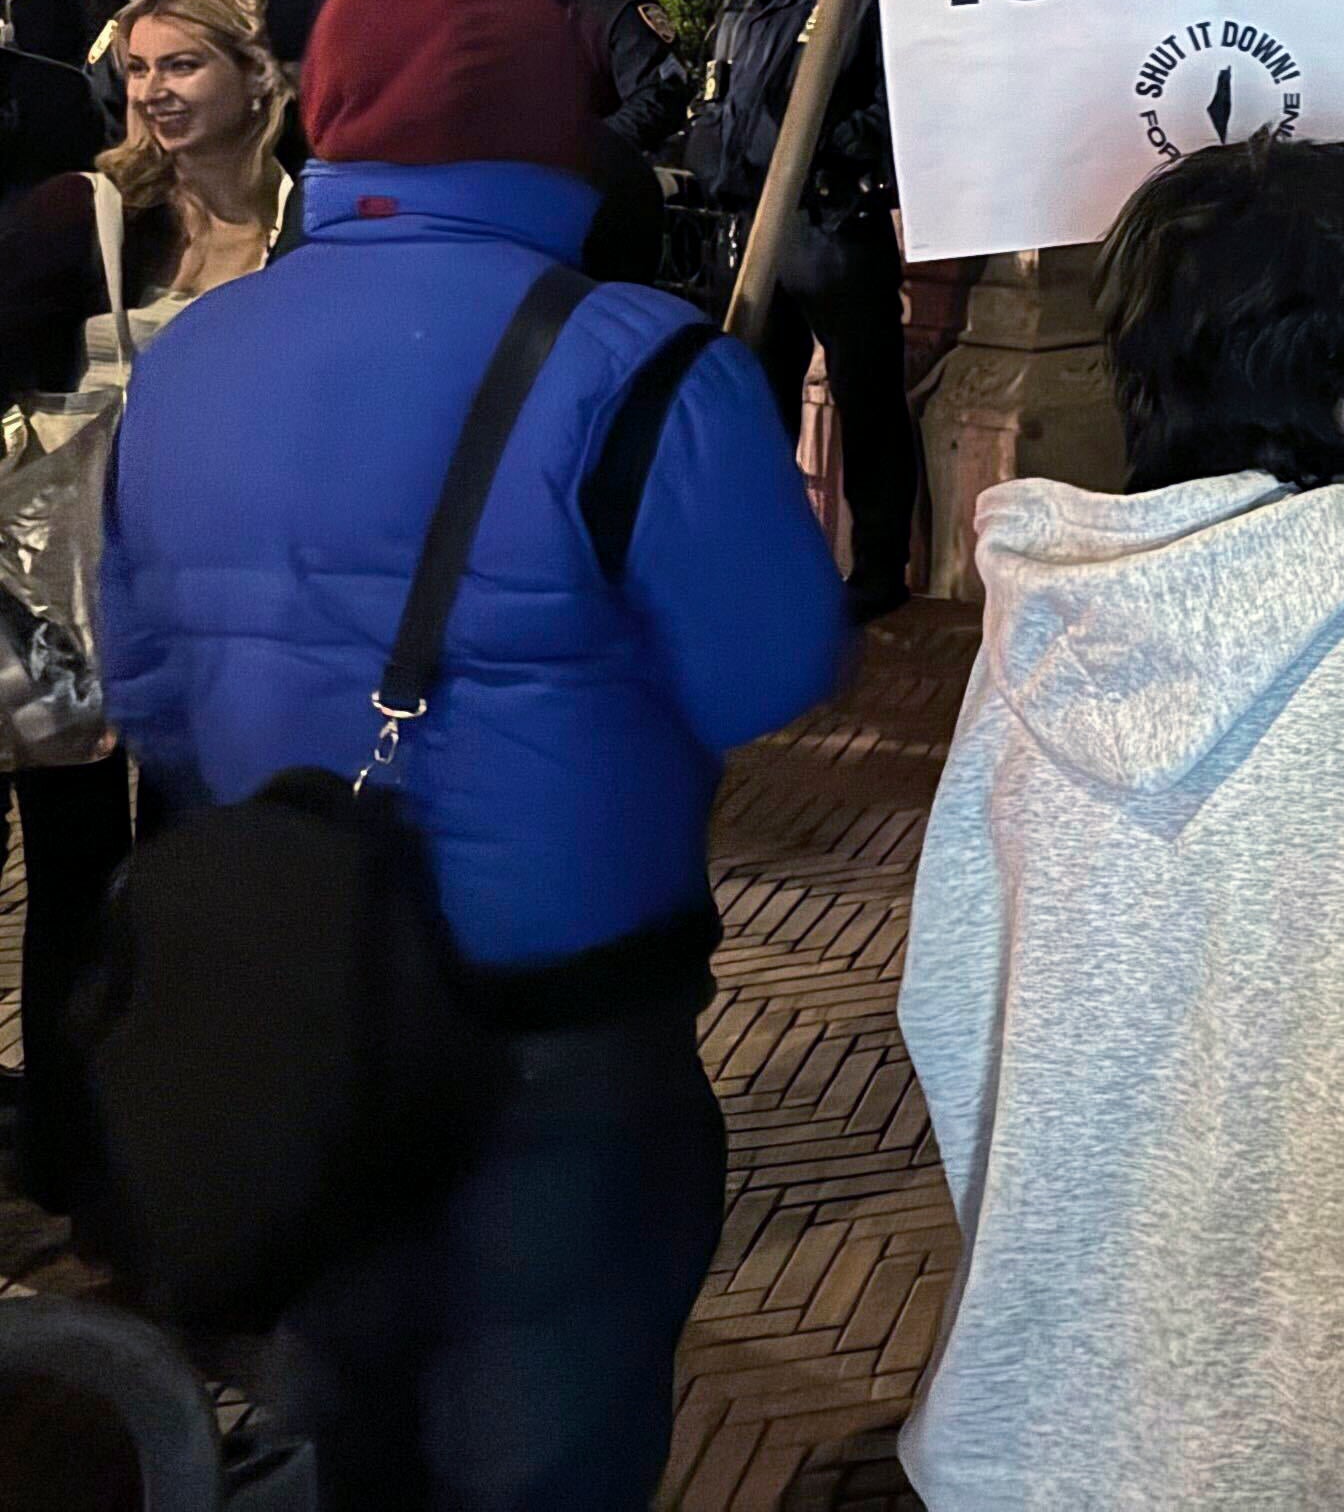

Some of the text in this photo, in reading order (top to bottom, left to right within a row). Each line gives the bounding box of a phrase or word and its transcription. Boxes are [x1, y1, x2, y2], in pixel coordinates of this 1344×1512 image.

[1135, 20, 1301, 99] SHUT IT DOWN!
[1139, 110, 1182, 161] FOR
